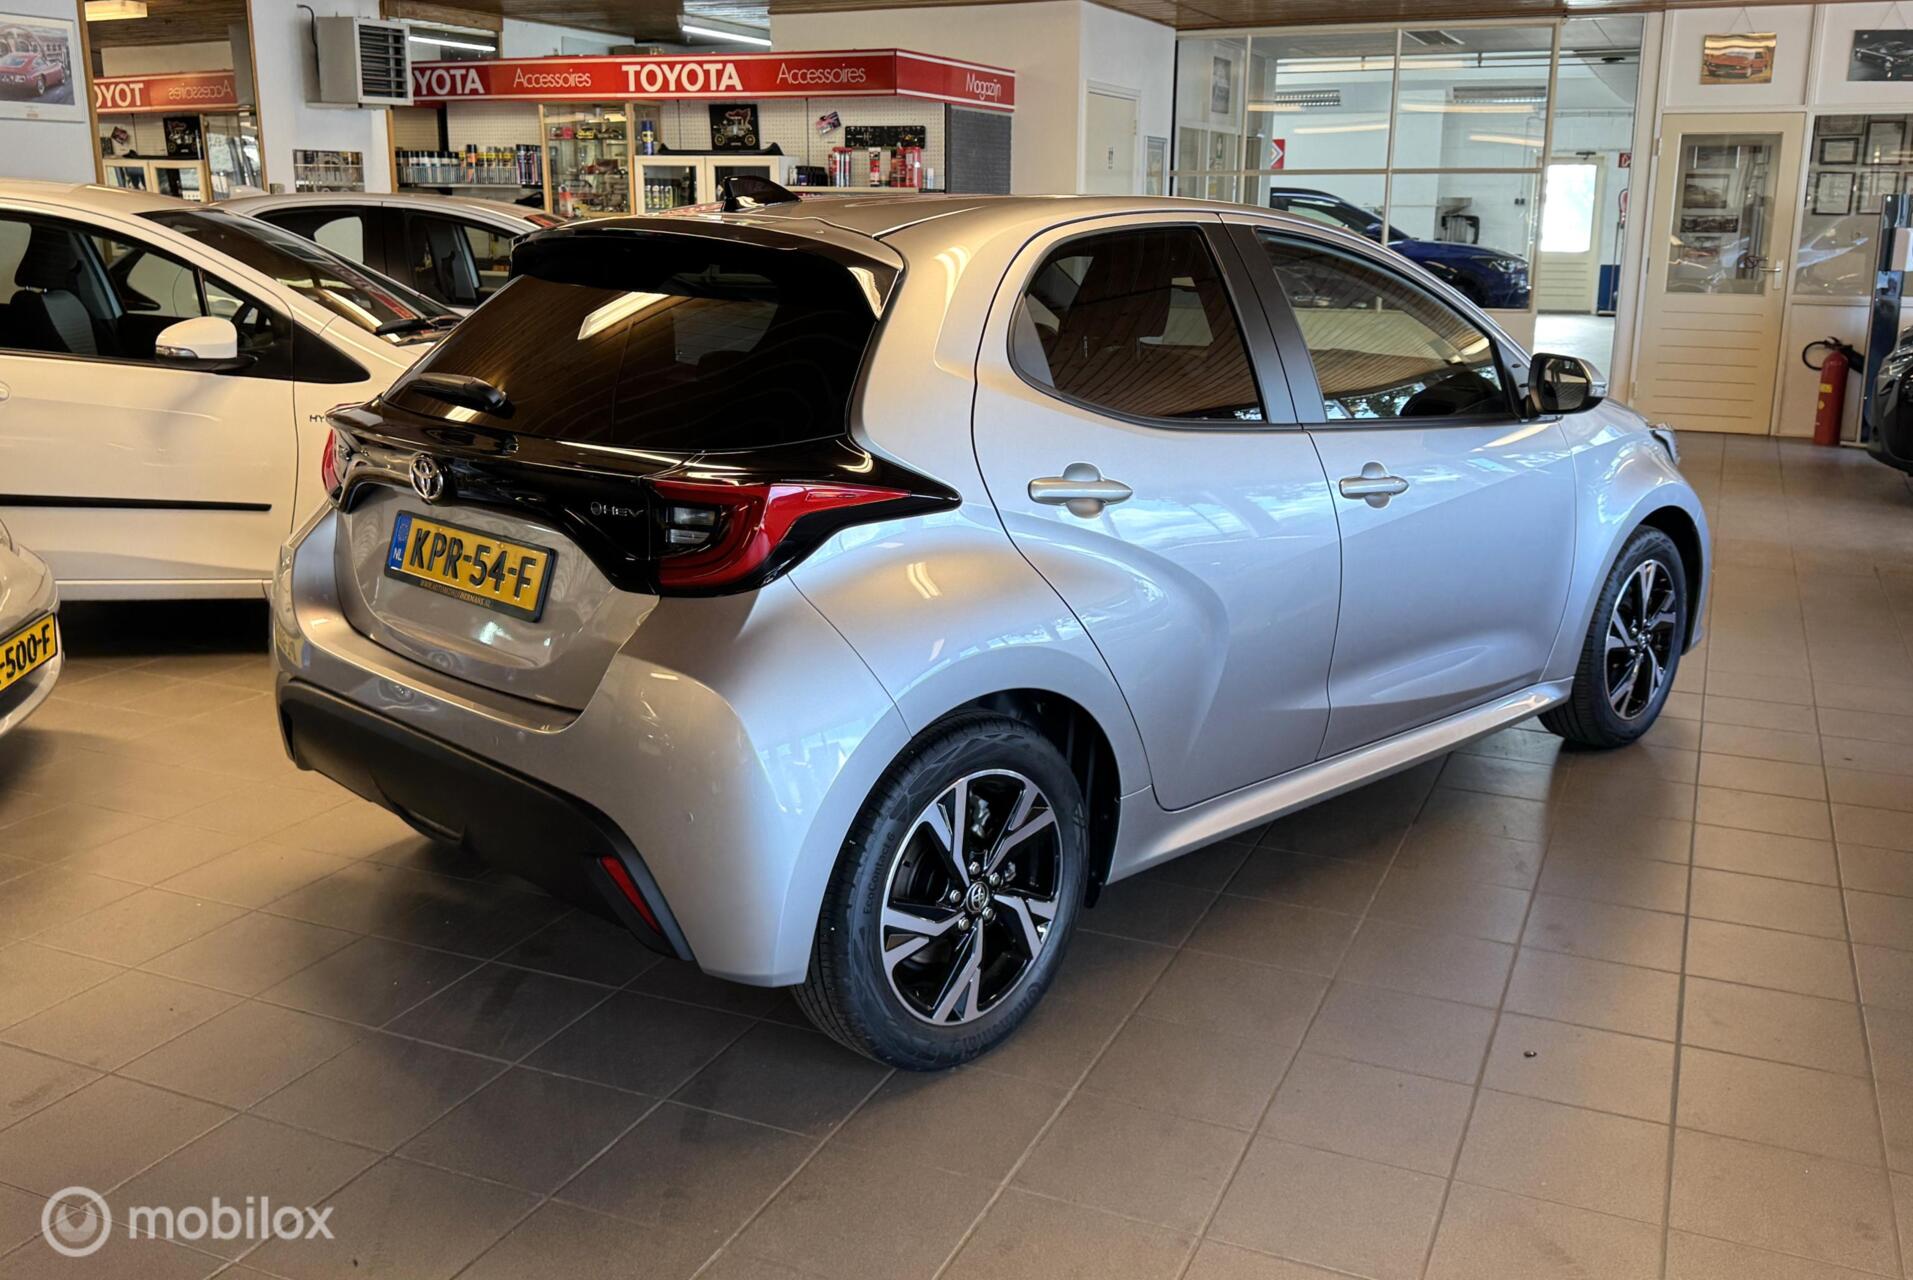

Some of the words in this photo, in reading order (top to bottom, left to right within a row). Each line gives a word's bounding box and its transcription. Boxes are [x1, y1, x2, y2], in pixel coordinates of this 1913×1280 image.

[412, 69, 485, 95] YOTA
[513, 68, 592, 88] Accessoires
[621, 62, 744, 92] TOYOTA
[776, 62, 867, 84] Accessoires
[392, 546, 403, 562] NL
[408, 527, 537, 601] KPR-54-F
